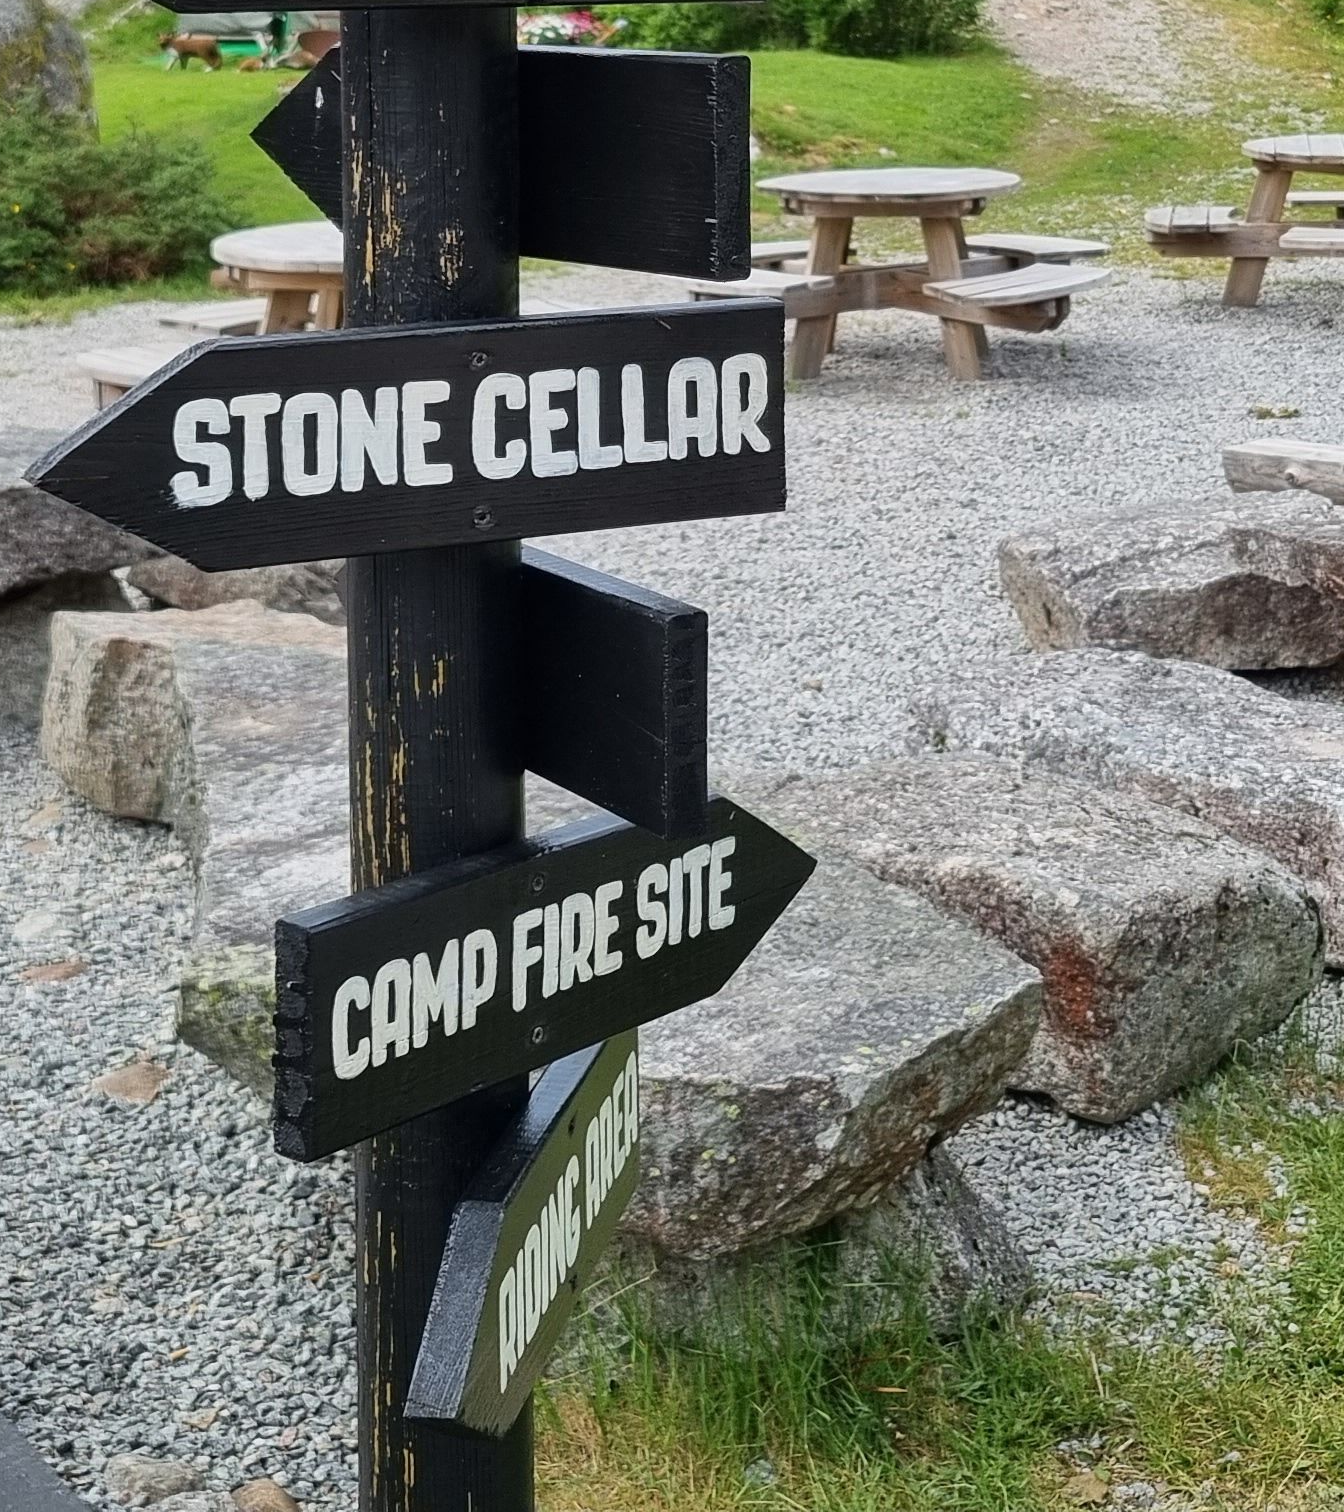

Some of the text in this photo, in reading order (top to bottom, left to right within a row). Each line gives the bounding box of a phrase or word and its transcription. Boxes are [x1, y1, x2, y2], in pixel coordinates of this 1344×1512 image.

[169, 352, 771, 509] STONE CELLAR
[331, 836, 736, 1080] CAMP FIRE SITE
[498, 1050, 639, 1394] RIDING AREA
